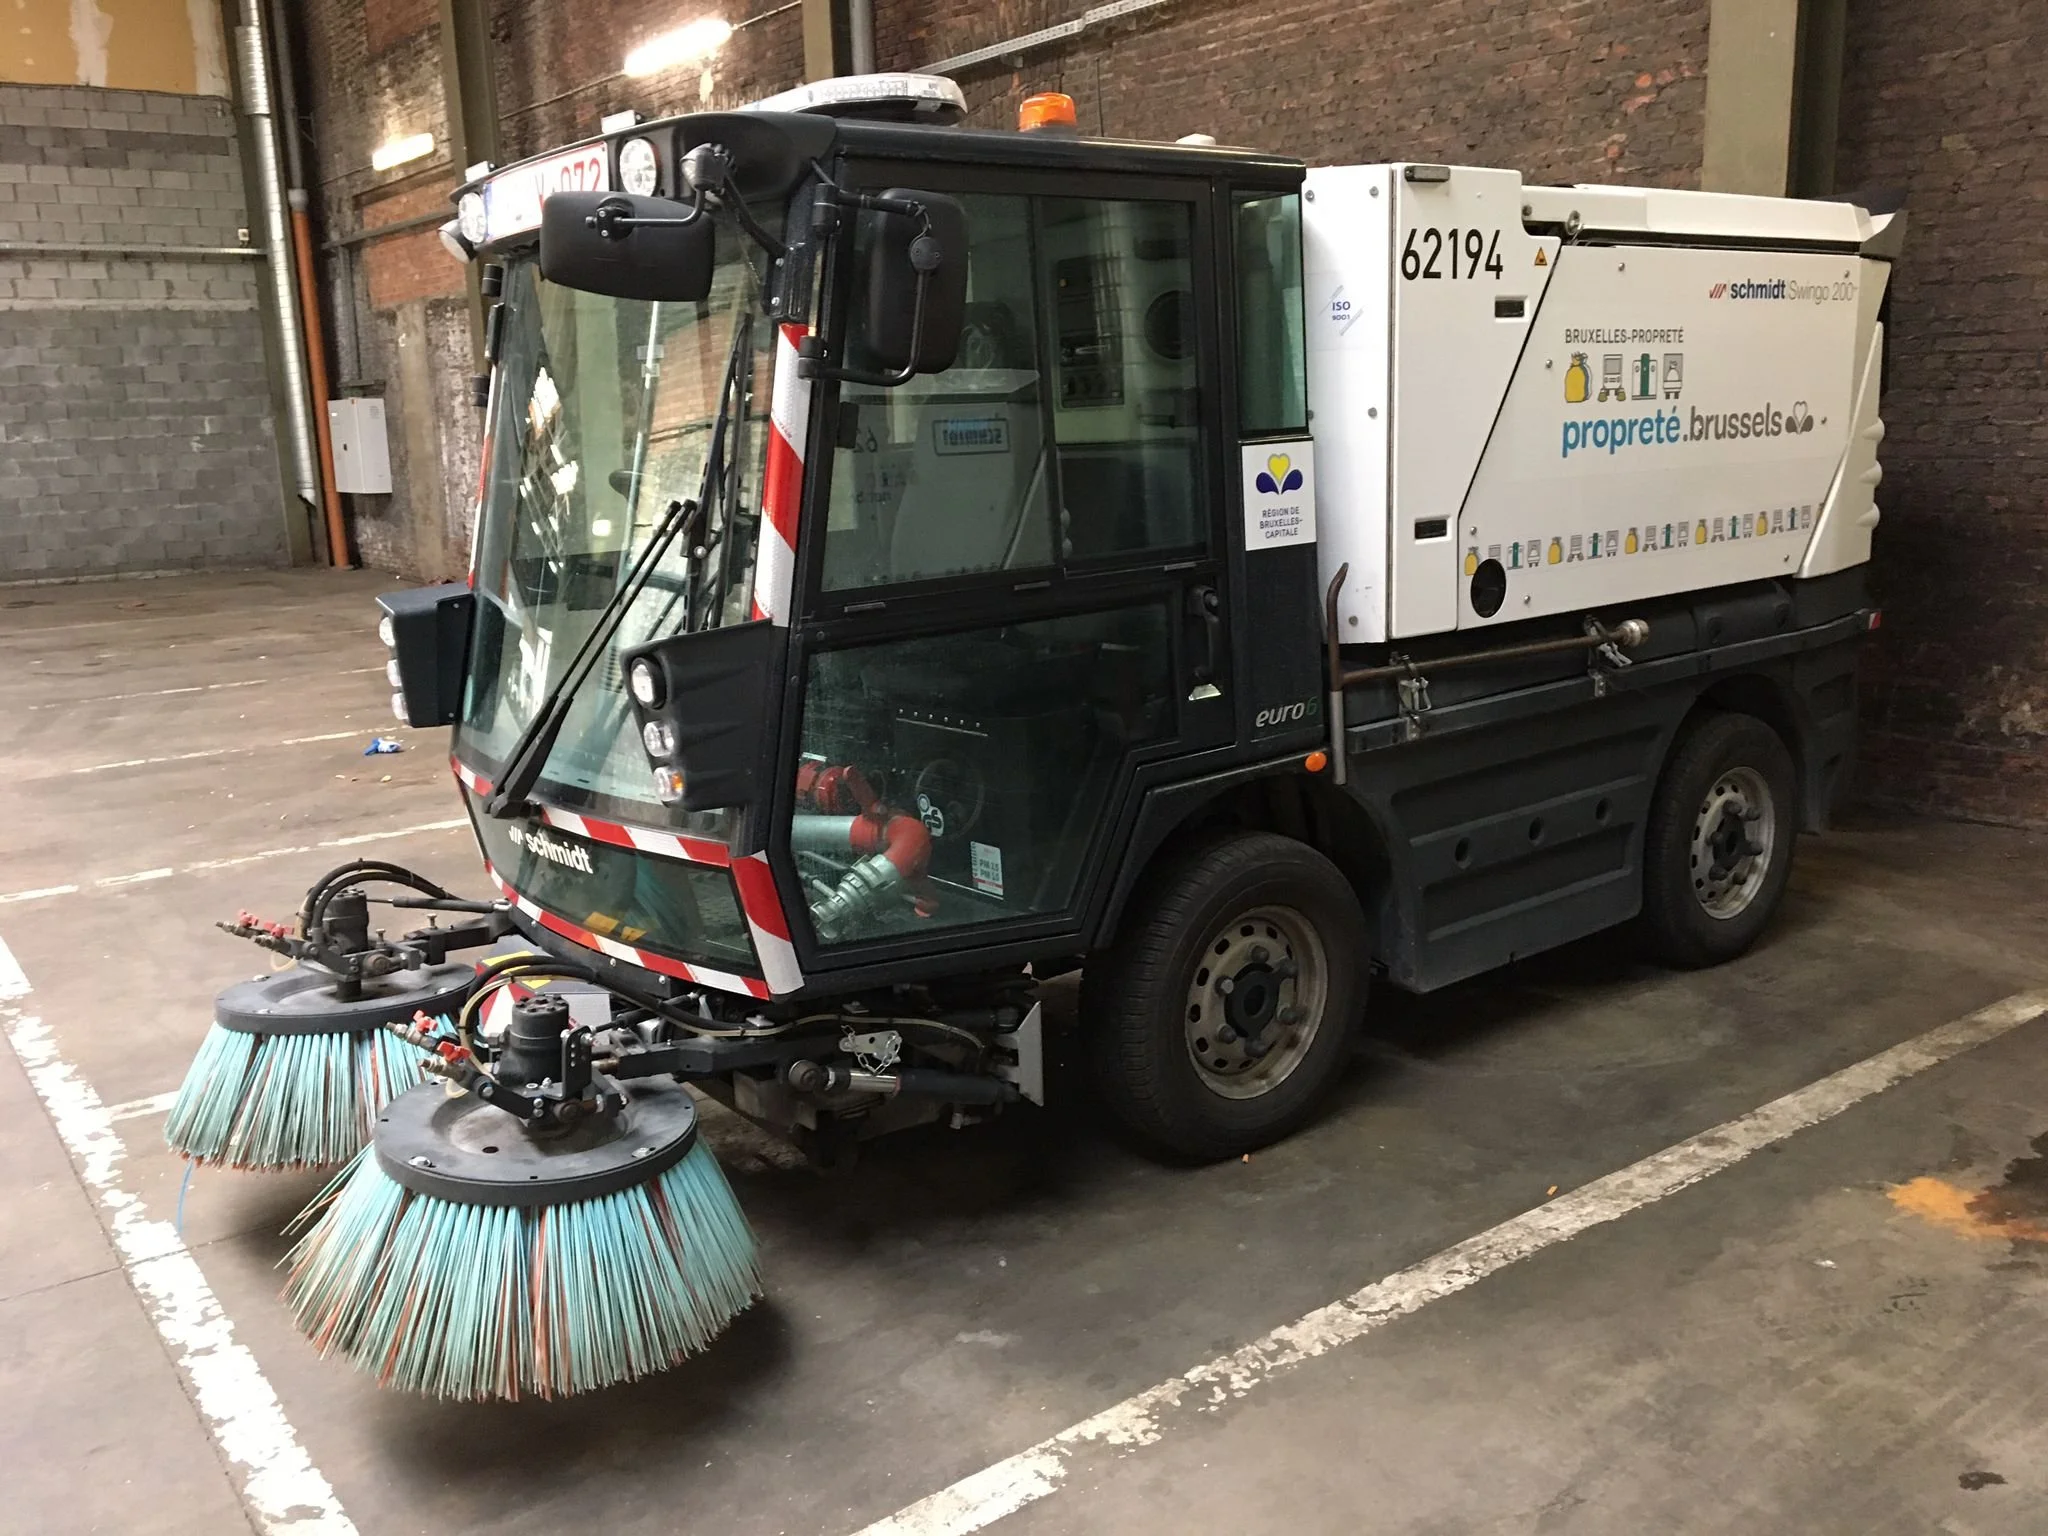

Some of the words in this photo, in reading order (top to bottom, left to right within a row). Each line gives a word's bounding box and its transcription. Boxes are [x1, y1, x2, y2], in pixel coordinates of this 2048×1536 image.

[1401, 227, 1503, 281] 62194
[1730, 279, 1786, 300] schmidt
[1788, 280, 1830, 305] Swingo
[1332, 301, 1351, 311] ISO
[1564, 326, 1685, 344] BRUXELLES-PROPRETÉ
[1562, 402, 1783, 459] propreté.brussels
[1290, 506, 1300, 515] DE
[1260, 517, 1303, 529] BRUXELLES-
[1265, 527, 1299, 539] CAPITALE
[525, 830, 594, 875] schmidt
